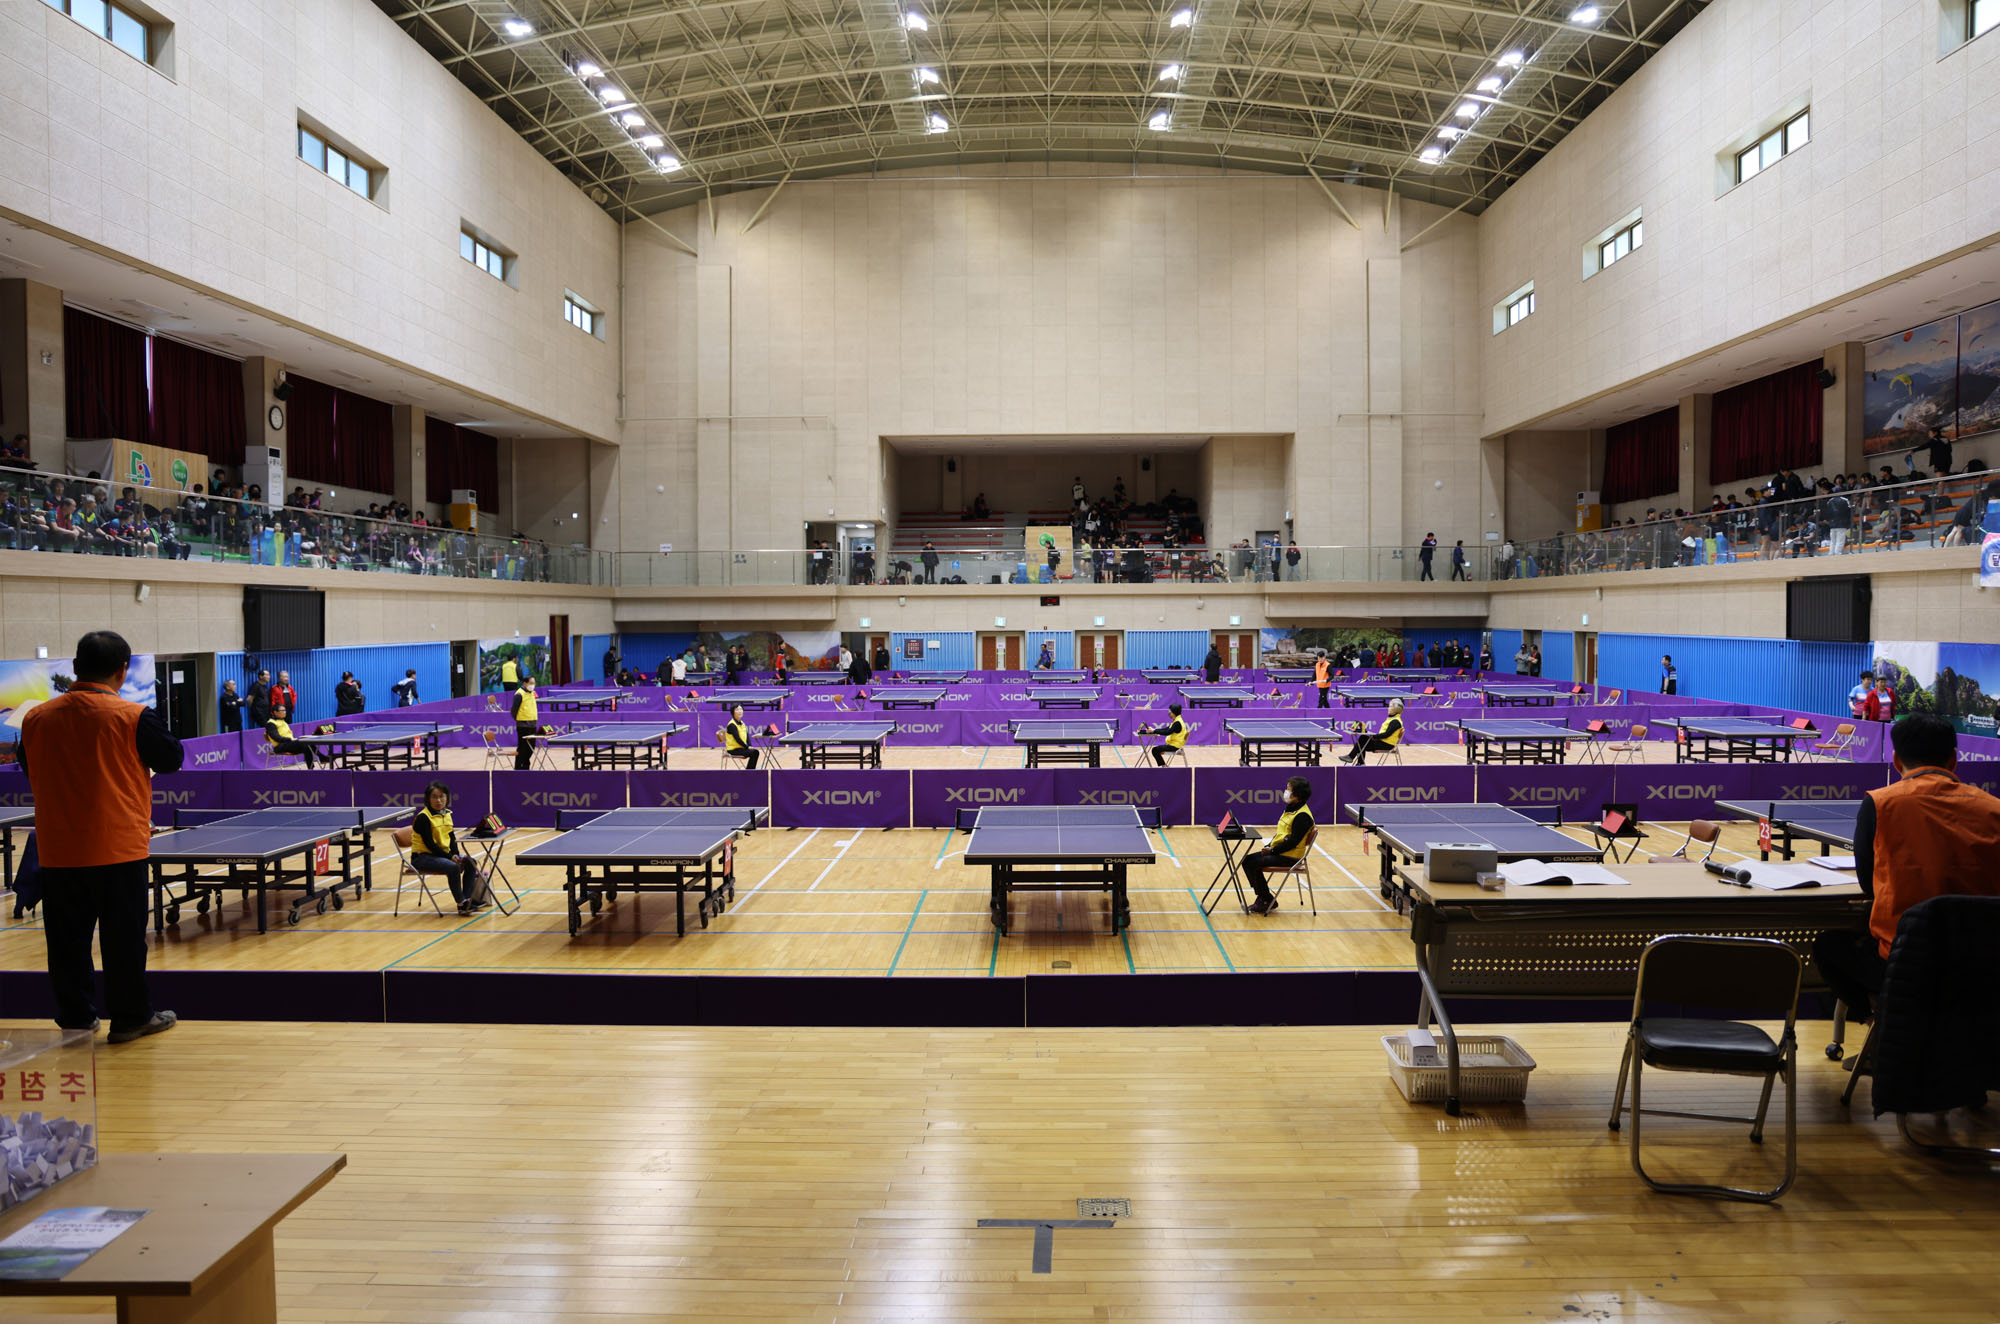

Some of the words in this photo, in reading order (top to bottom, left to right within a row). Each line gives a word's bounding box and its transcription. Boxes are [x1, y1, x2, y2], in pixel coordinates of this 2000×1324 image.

[470, 725, 513, 734] XIOM
[895, 723, 937, 733] XIOM
[195, 750, 226, 765] XIOM
[253, 791, 319, 804] XIOM
[802, 790, 874, 805] XIOM
[945, 788, 1018, 802] XIOM
[1079, 790, 1150, 804] XIOM
[1367, 787, 1438, 801] XIOM
[1508, 787, 1580, 801] XIOM
[1647, 785, 1717, 799] XIOM
[1782, 786, 1852, 799] XIOM
[521, 792, 590, 807] XIOM
[660, 792, 732, 807] XIOM
[1760, 823, 1770, 839] 23
[317, 843, 328, 862] 27
